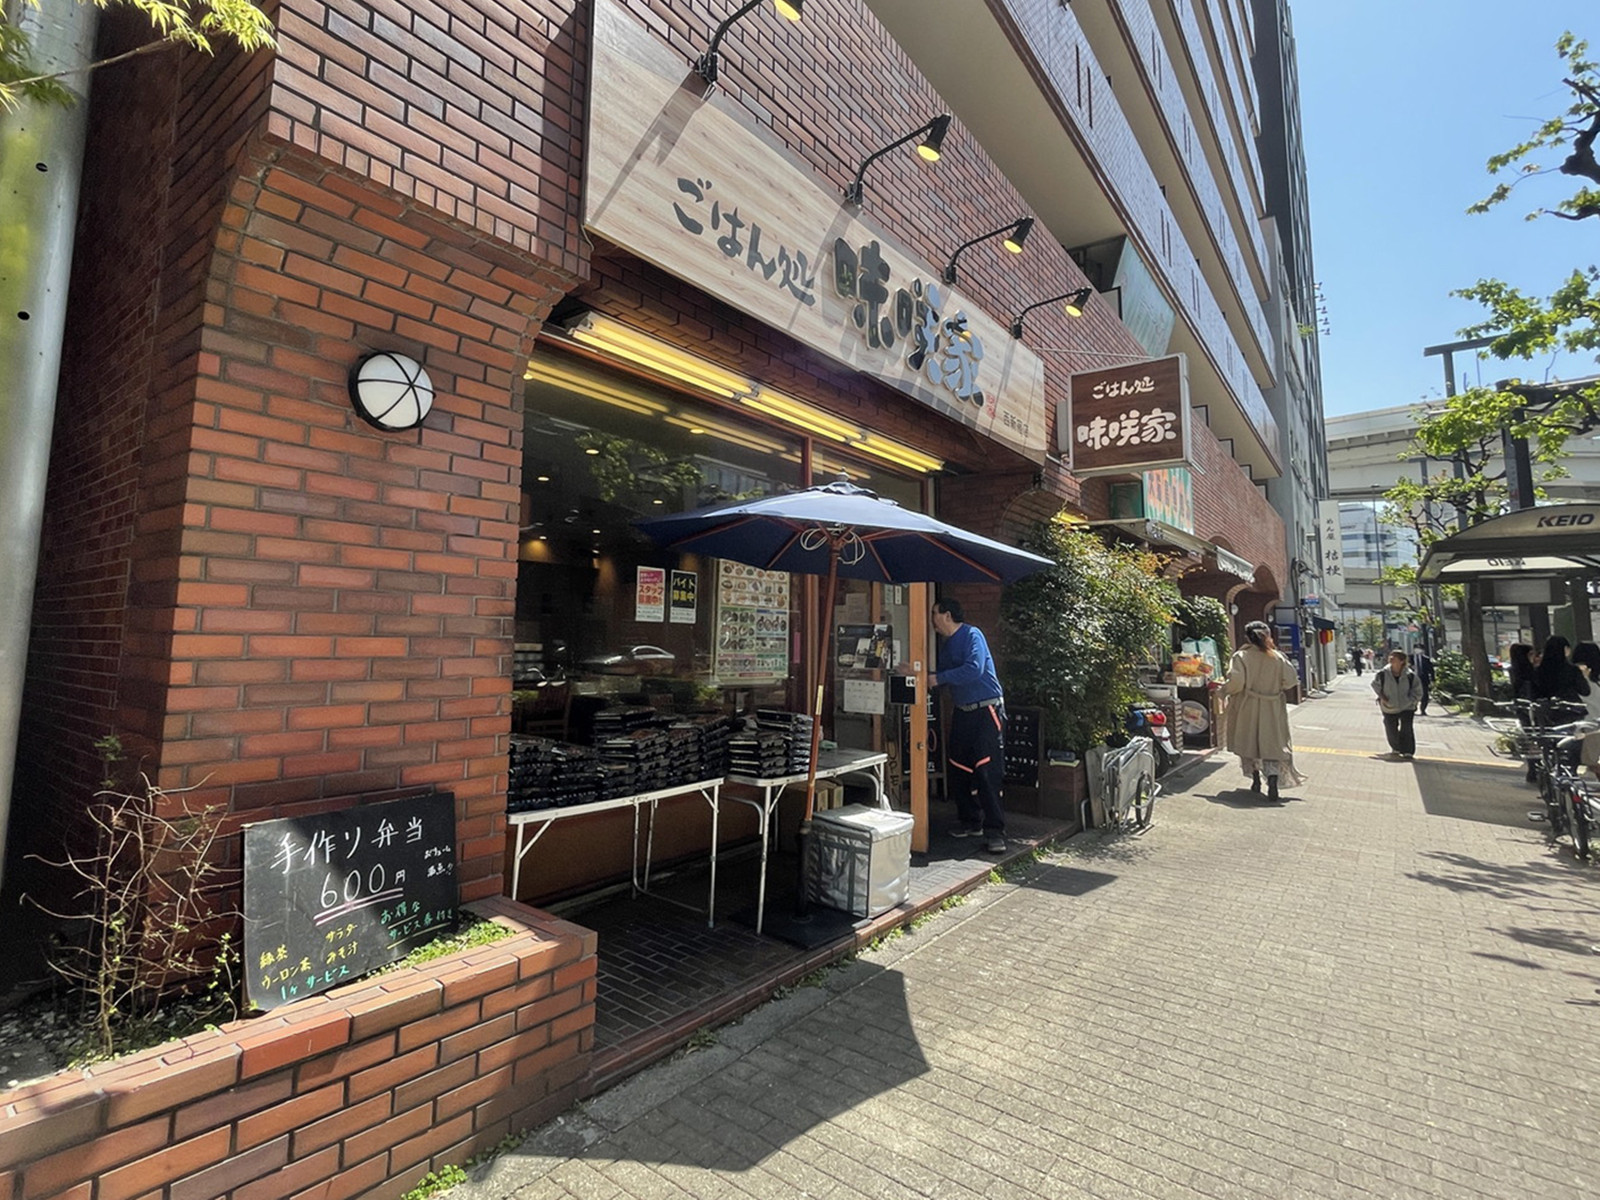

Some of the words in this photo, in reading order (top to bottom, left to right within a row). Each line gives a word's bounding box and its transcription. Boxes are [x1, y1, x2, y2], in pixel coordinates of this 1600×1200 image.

[673, 177, 816, 307] ごはん処
[833, 237, 985, 408] 味咲家
[1092, 376, 1155, 399] ごはん処
[1077, 407, 1177, 450] 味咲家
[1537, 513, 1595, 528] KEIO
[320, 863, 406, 908] 600円
